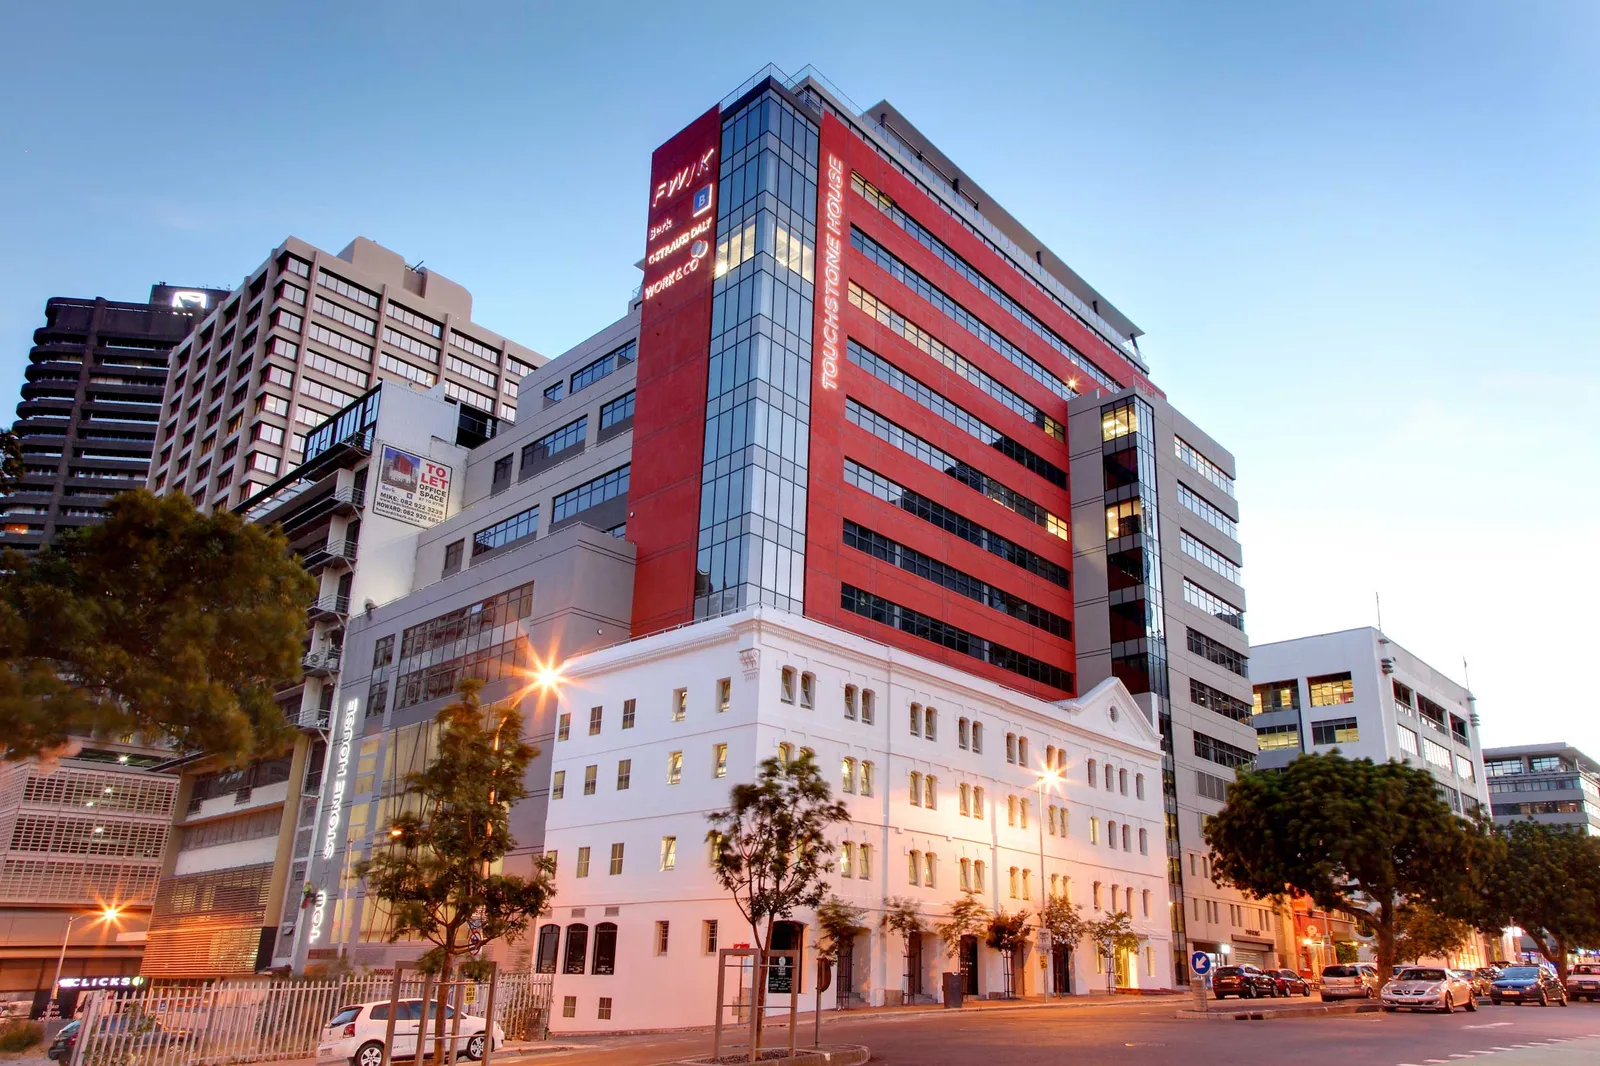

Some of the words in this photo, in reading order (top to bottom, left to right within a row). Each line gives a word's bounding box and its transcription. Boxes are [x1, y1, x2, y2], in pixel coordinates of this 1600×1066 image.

[828, 153, 844, 236] HOUSE
[690, 216, 712, 240] DALY
[822, 232, 841, 390] TOUCHSTONE
[426, 463, 446, 478] TO
[420, 472, 449, 489] LET
[419, 484, 446, 497] OFFICE
[419, 490, 444, 503] SPACE
[400, 498, 412, 506] 082
[402, 509, 415, 517] 082
[336, 698, 358, 777] HOUSE
[1245, 929, 1261, 937] PARKING
[72, 977, 131, 987] CLICKS
